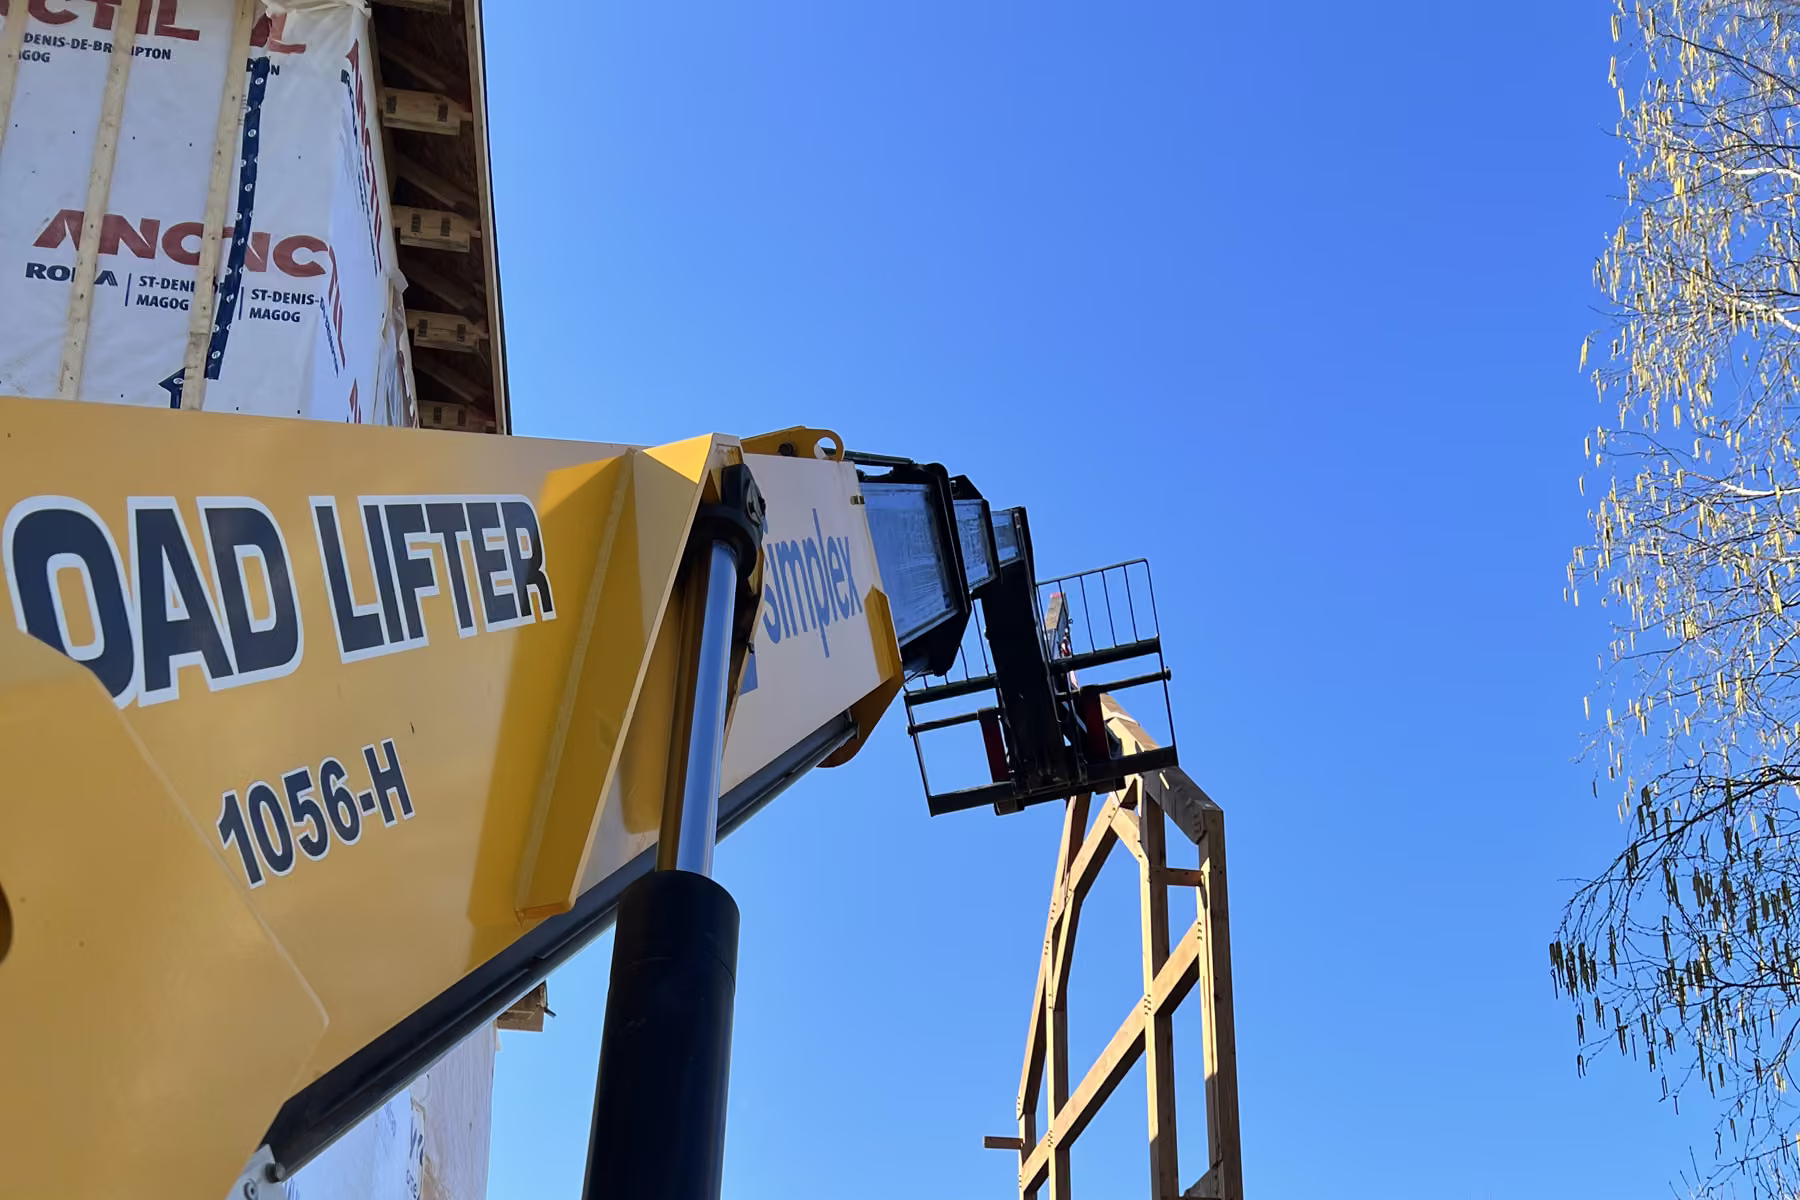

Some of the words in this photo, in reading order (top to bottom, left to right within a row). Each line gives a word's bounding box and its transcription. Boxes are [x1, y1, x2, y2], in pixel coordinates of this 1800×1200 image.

[25, 262, 118, 287] ROA
[136, 294, 190, 311] MAGOG
[249, 307, 301, 323] MAGOG
[309, 494, 557, 664] LIFTER
[763, 508, 863, 658] simplex
[216, 738, 415, 889] 1056-H
